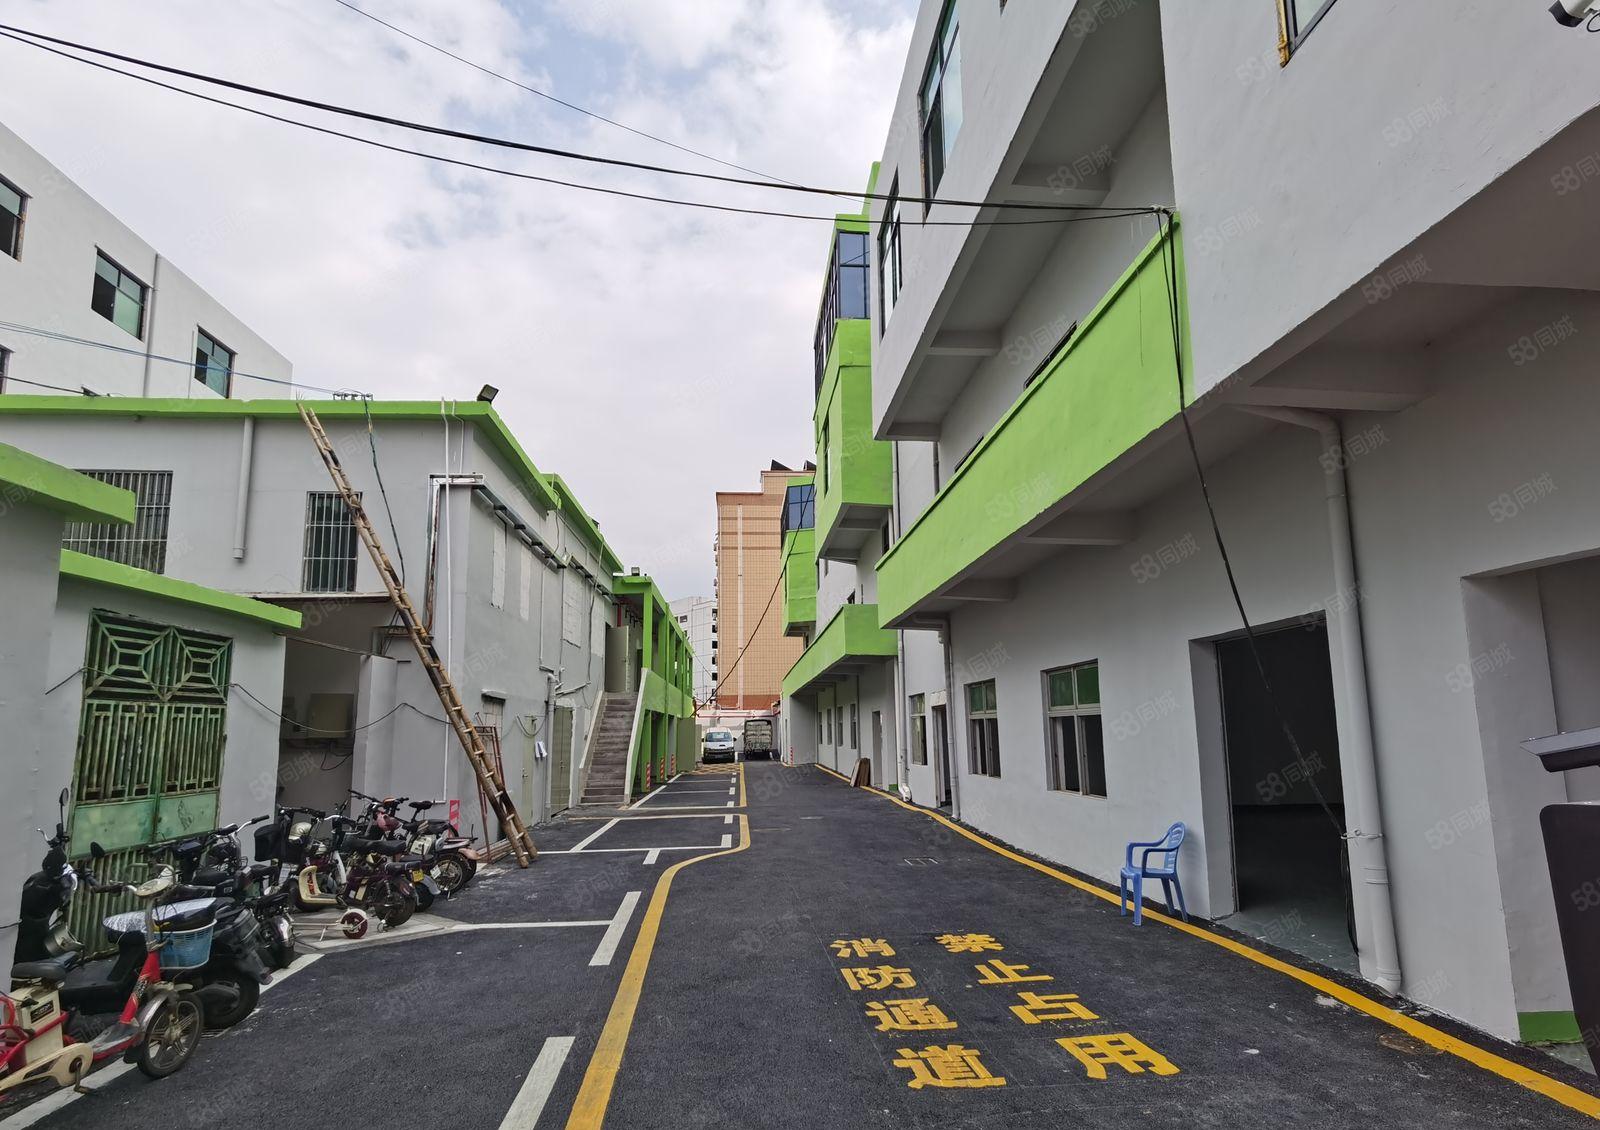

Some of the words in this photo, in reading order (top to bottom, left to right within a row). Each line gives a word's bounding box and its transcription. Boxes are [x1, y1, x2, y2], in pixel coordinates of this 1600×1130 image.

[830, 938, 1006, 1089] 消防通道
[936, 933, 1180, 1079] 禁止占用
